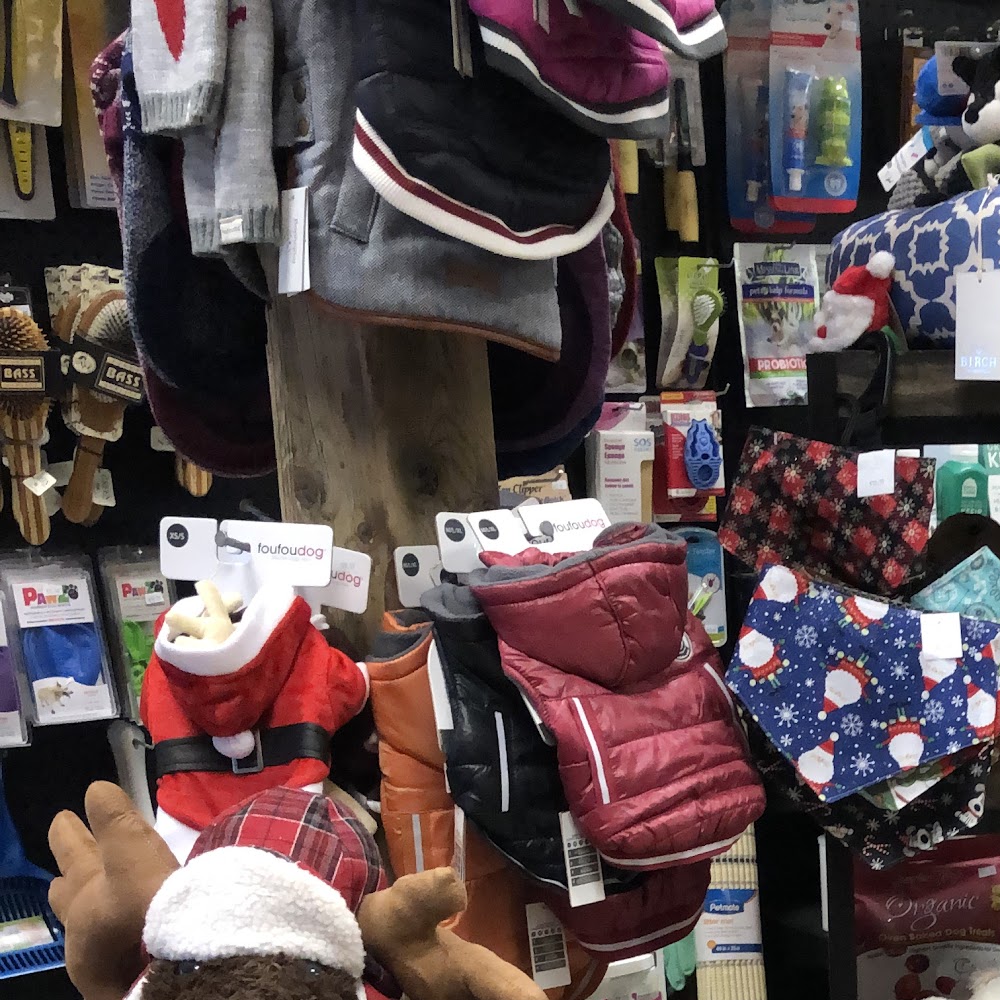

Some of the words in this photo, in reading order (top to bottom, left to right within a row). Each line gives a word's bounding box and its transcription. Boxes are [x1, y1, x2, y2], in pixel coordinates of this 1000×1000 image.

[960, 356, 997, 368] BIRCH
[4, 367, 36, 380] BASS
[105, 366, 141, 388] BASS
[633, 437, 652, 447] SOS
[553, 516, 605, 534] foufoudog
[257, 542, 324, 560] foufoudog
[709, 903, 740, 912] Petmate
[885, 895, 977, 932] Organic
